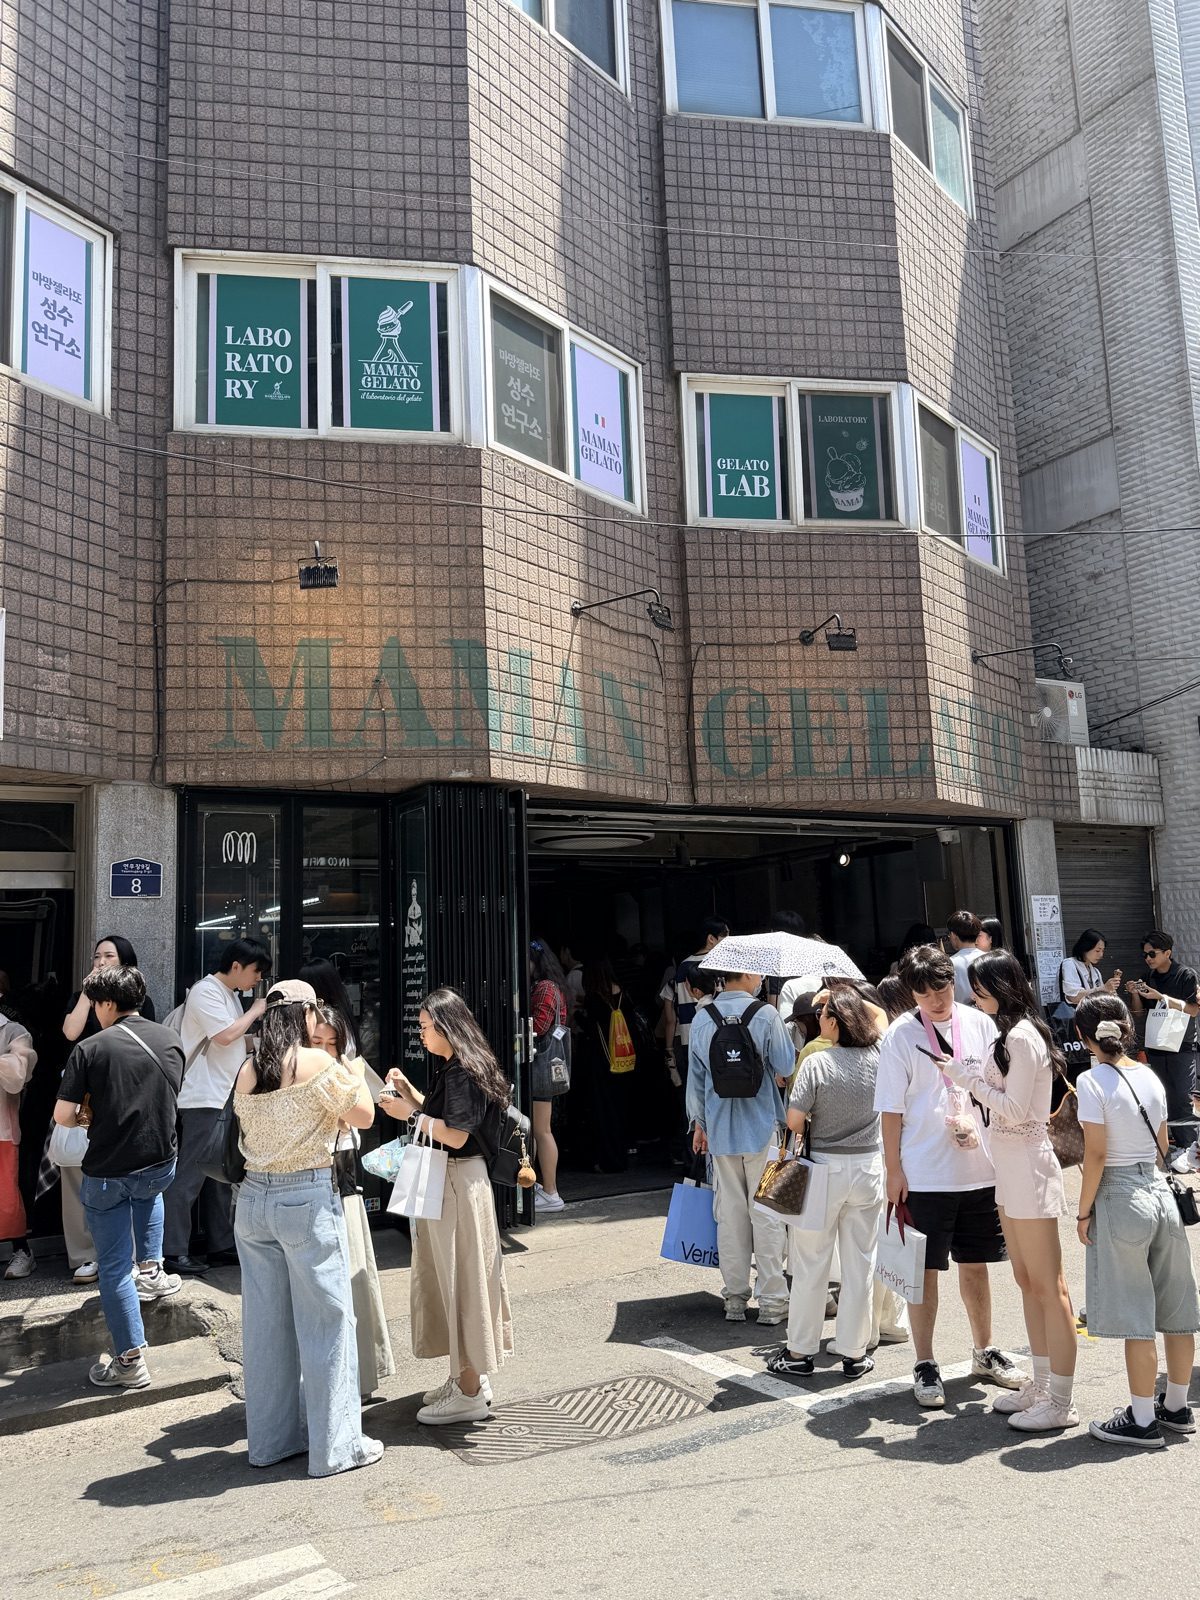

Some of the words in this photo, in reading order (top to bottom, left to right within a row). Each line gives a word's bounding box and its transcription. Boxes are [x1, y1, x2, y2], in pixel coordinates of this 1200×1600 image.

[32, 271, 82, 304] 마망젤라또
[40, 297, 74, 327] 성수
[32, 321, 81, 359] 연구소
[224, 326, 291, 347] LABO
[224, 352, 293, 374] RATO
[362, 363, 419, 377] MAMAN
[499, 349, 541, 382] 마망젤라또
[224, 379, 259, 399] RY
[361, 376, 421, 390] GELATO
[507, 376, 535, 407] 성수
[501, 403, 543, 440] 연구소
[818, 416, 868, 424] LABORATORY
[581, 428, 620, 458] MAMAN
[581, 445, 622, 475] GELATO
[716, 458, 770, 471] GELATO
[717, 473, 771, 498] LAB
[967, 507, 989, 529] MAMAN
[208, 636, 649, 774] MAMAN
[131, 878, 141, 893] 8
